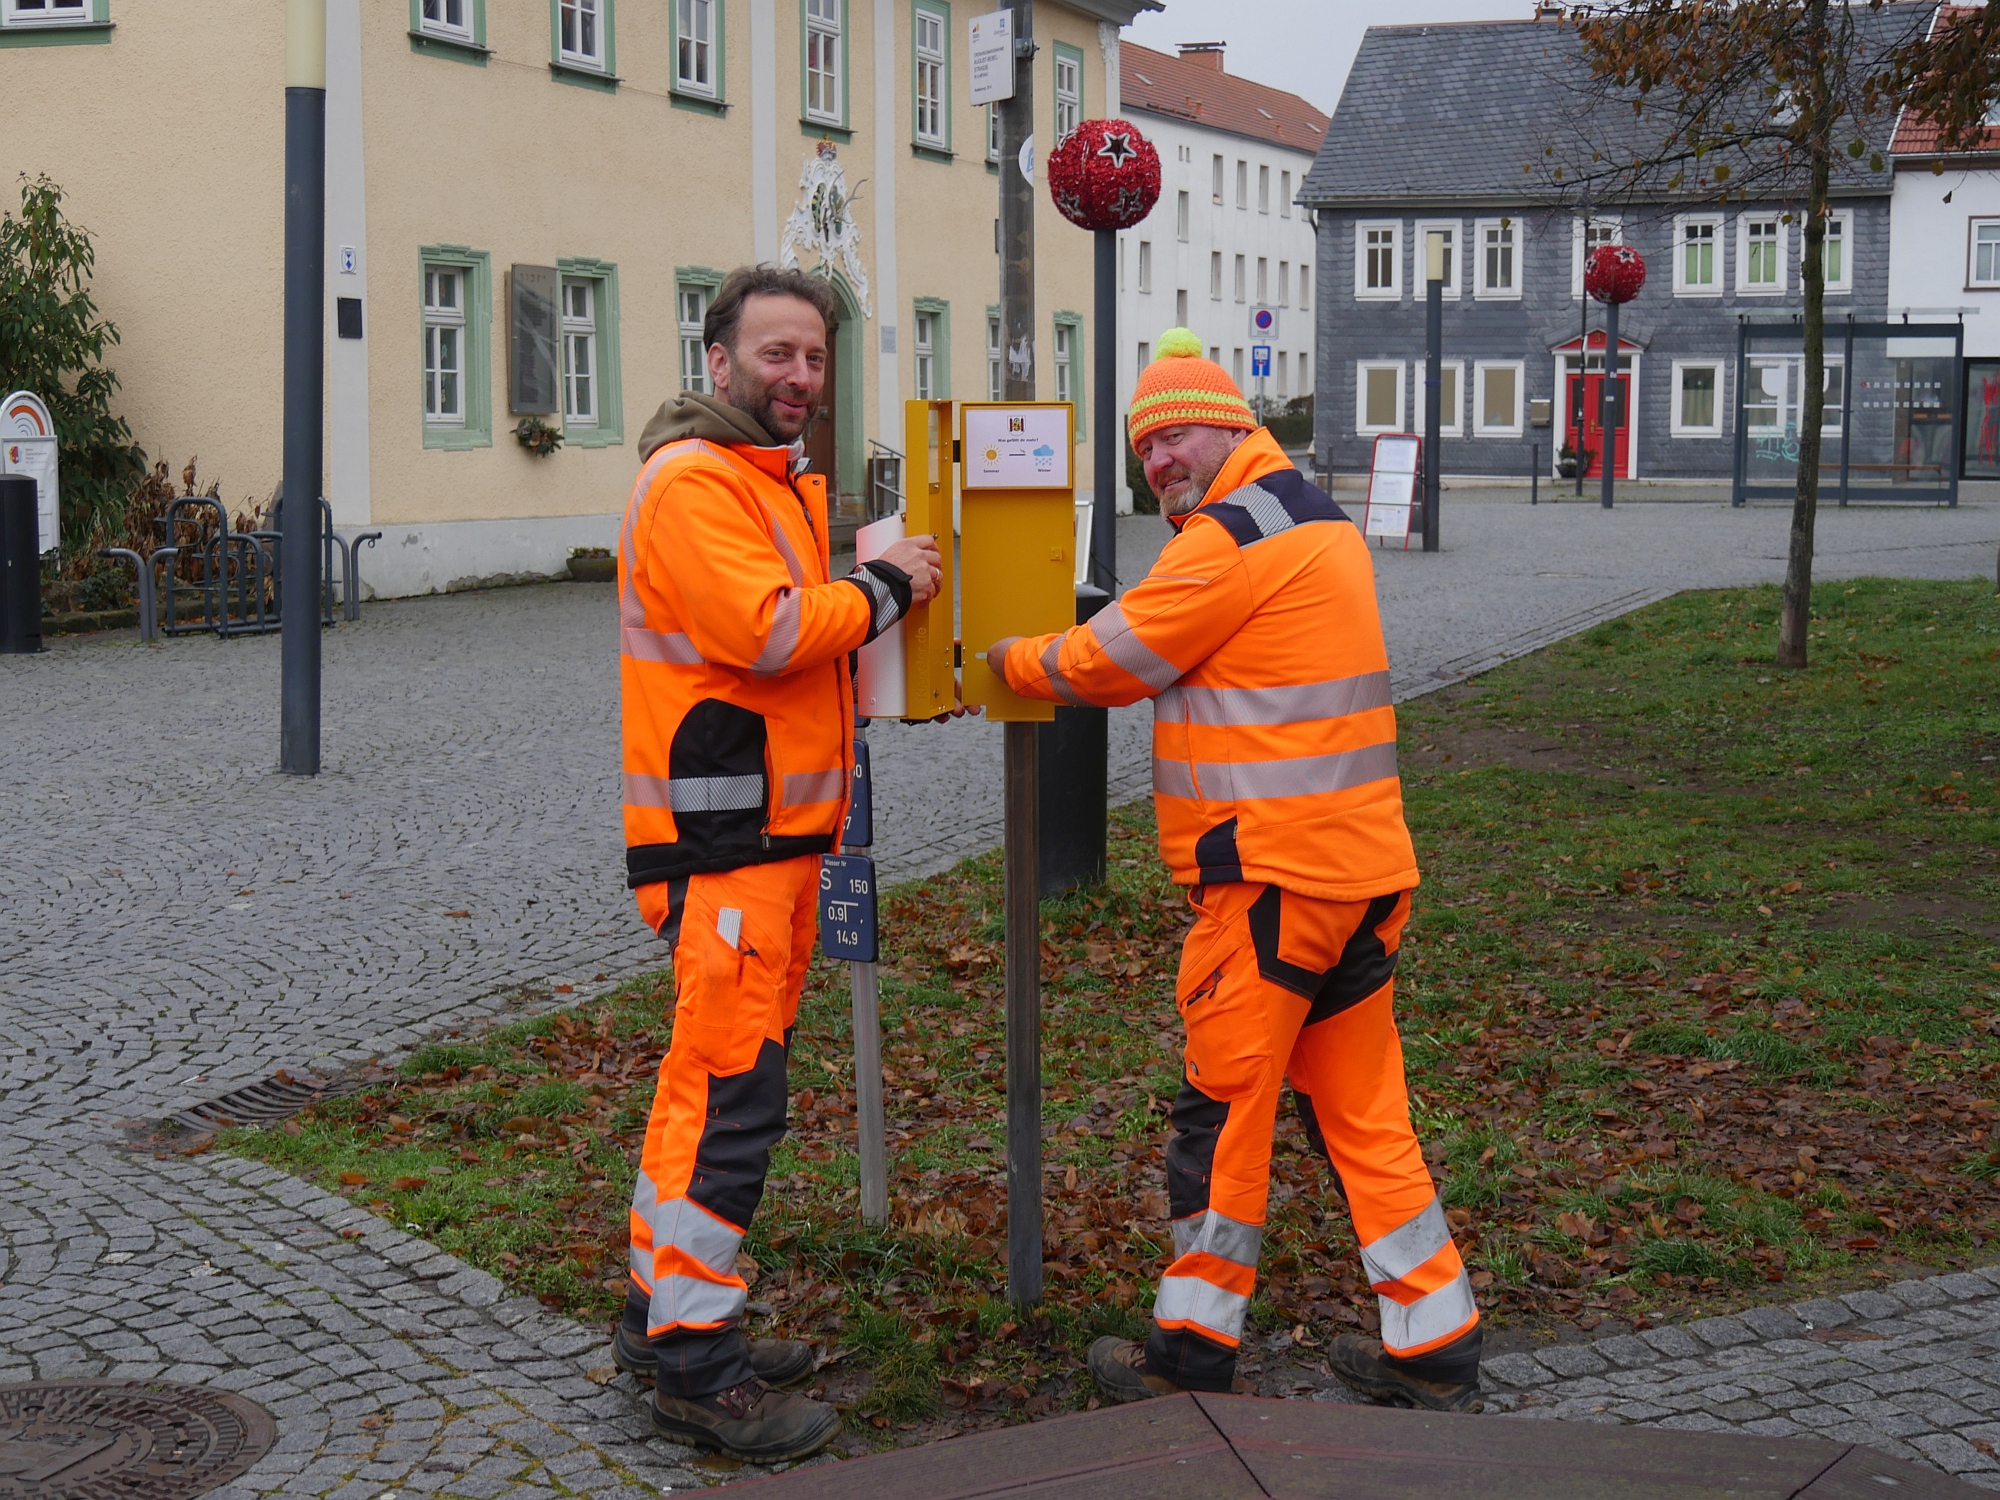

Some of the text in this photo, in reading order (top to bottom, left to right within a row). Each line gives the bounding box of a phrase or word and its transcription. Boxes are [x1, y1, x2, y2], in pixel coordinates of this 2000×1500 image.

[1594, 331, 1602, 344] 3
[820, 868, 868, 894] S 150
[837, 929, 858, 945] 14,9
